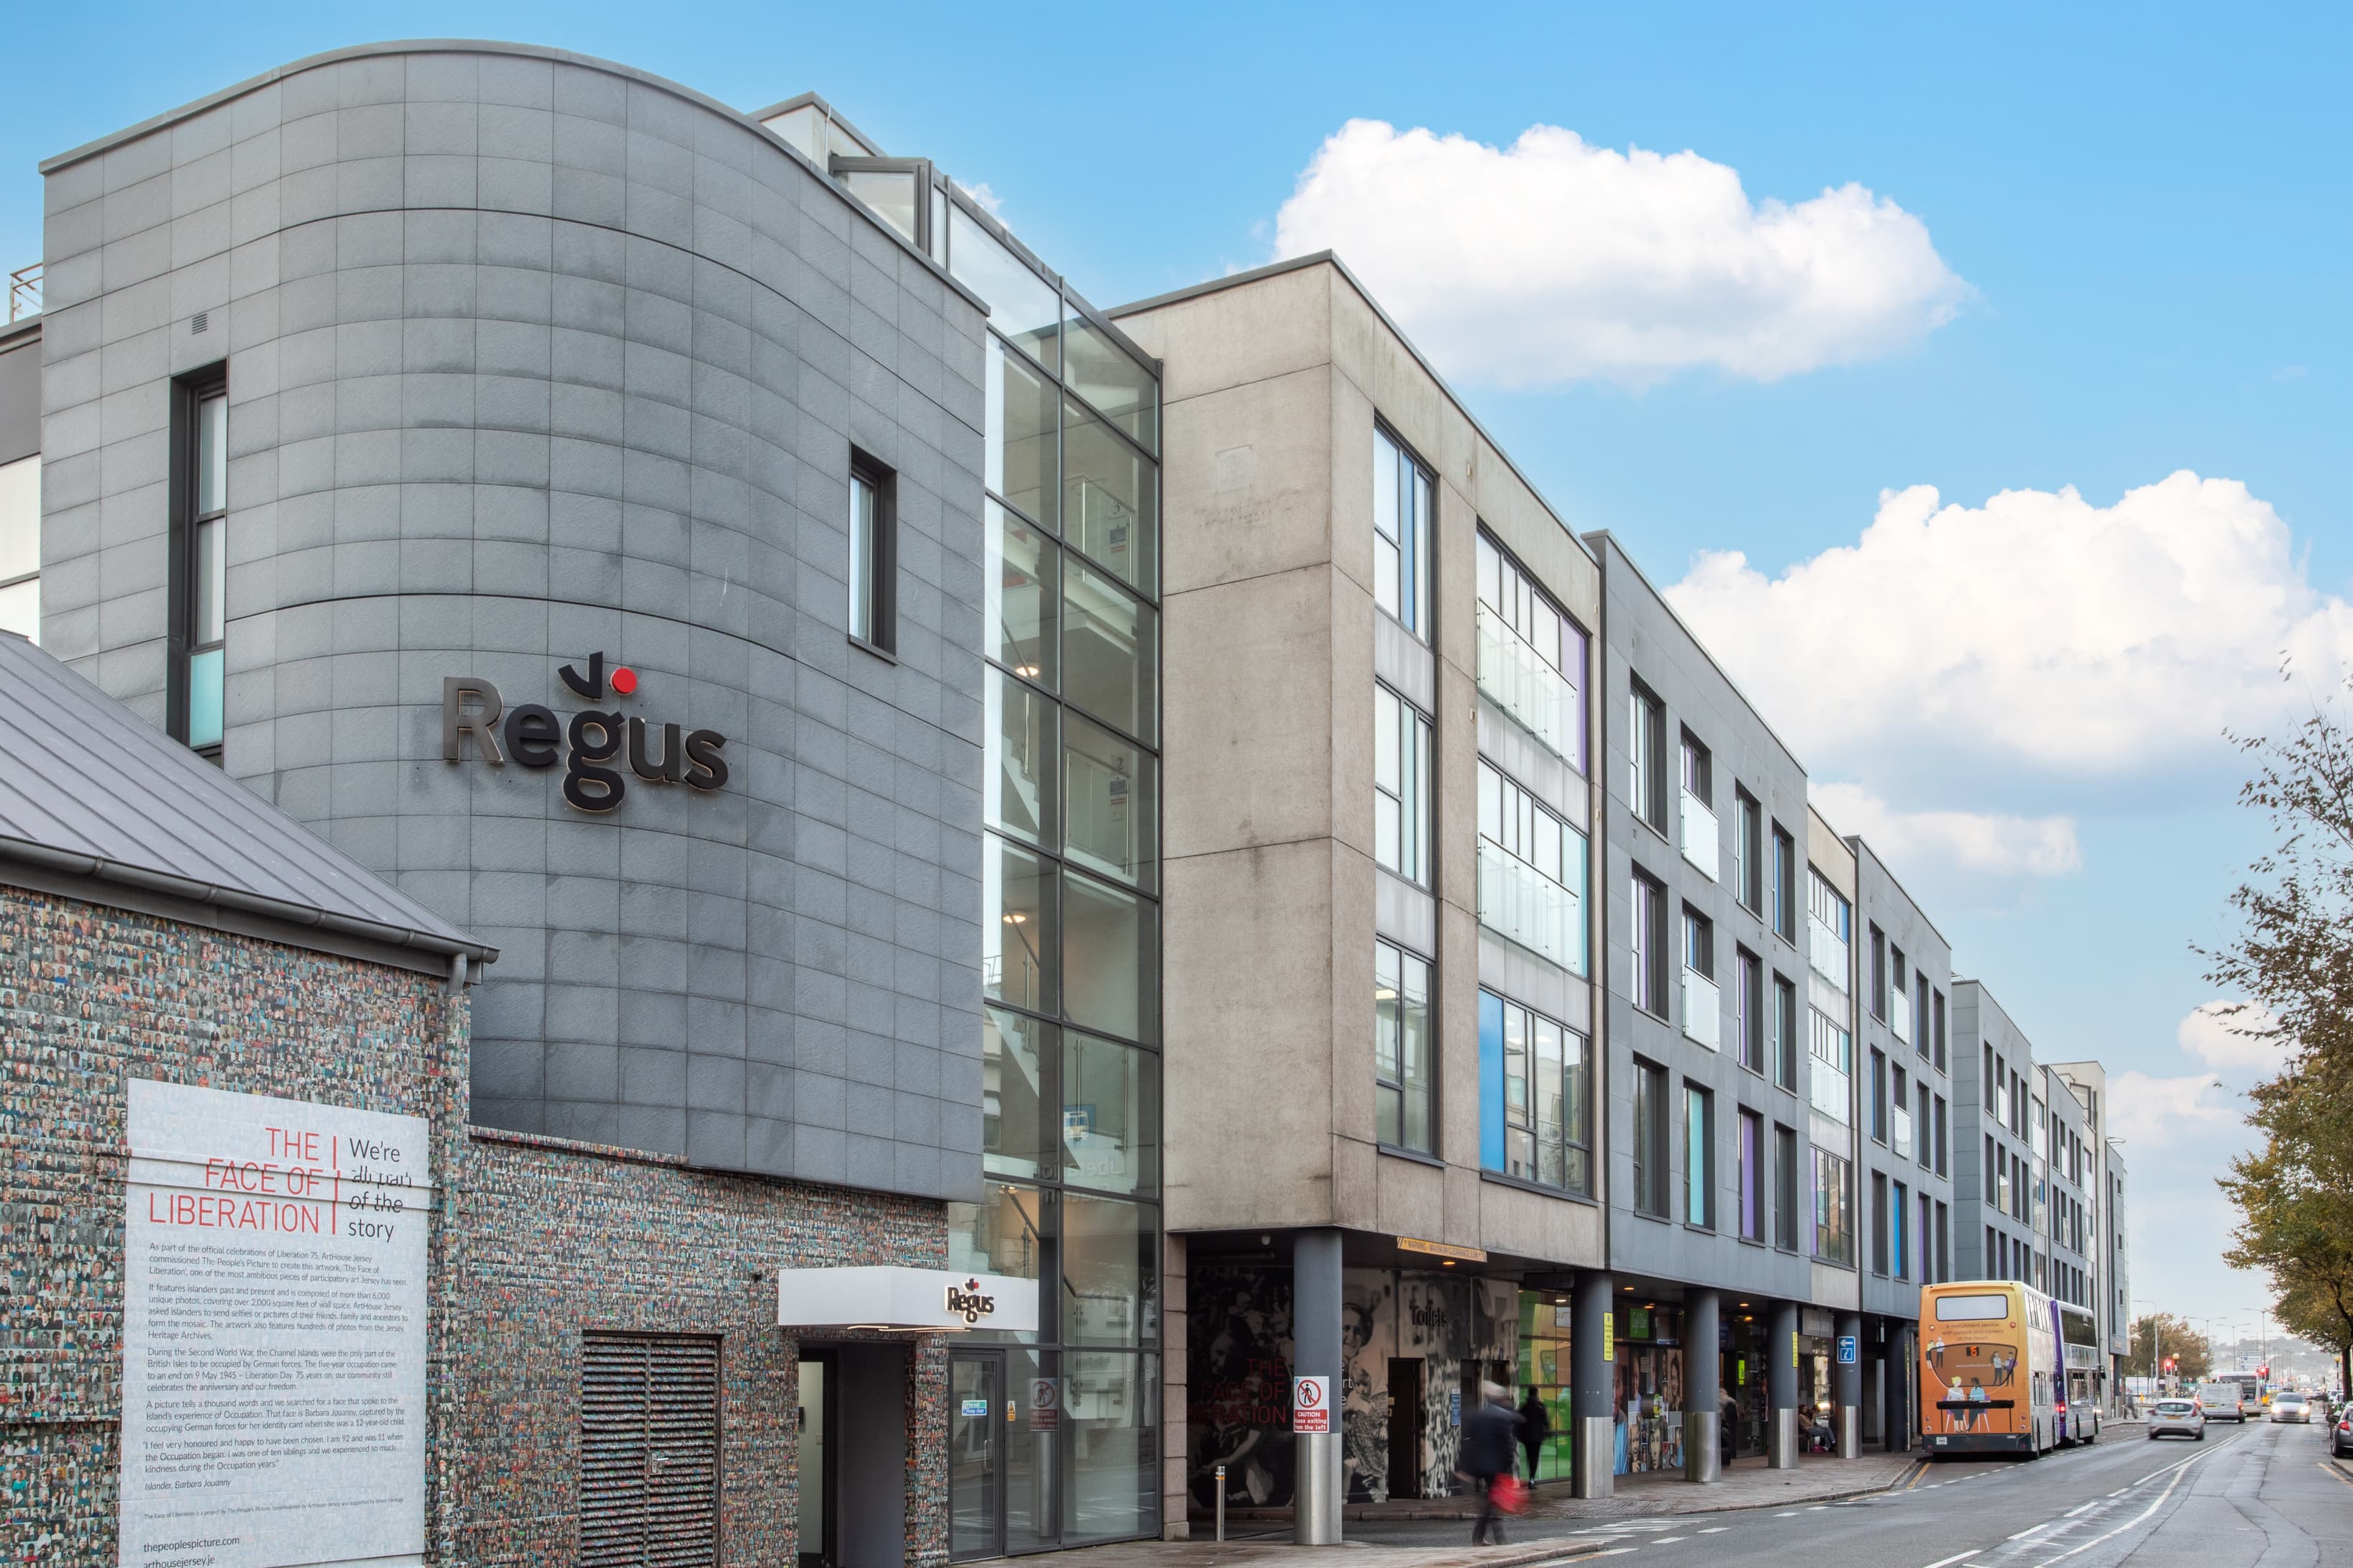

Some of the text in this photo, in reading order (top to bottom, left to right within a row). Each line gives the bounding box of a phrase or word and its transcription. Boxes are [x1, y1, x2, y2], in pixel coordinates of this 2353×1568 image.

[443, 676, 728, 812] Regus
[265, 1127, 320, 1162] THE
[349, 1137, 401, 1163] We're
[205, 1157, 324, 1196] FACE OF
[349, 1192, 403, 1213] of the
[149, 1192, 319, 1234] LIBERATION
[348, 1219, 394, 1243] story
[149, 1256, 200, 1265] commissioned
[201, 1257, 215, 1265] The
[217, 1258, 245, 1267] People's
[247, 1260, 270, 1268] Picture
[161, 1244, 176, 1253] part
[201, 1245, 224, 1254] official
[226, 1247, 266, 1256] celebrations
[277, 1250, 309, 1259] Liberation
[321, 1252, 351, 1261] ArtHouse
[352, 1255, 373, 1264] Jersey
[214, 1269, 225, 1278] the
[246, 1271, 278, 1280] ambitious
[280, 1273, 300, 1282] pieces
[310, 1275, 349, 1285] participatory
[360, 1277, 380, 1285] Jersey
[946, 1286, 995, 1324] Regus
[1409, 1304, 1448, 1326] Toilets
[147, 1348, 173, 1358] During
[349, 1349, 363, 1359] only
[210, 1360, 241, 1370] occupied
[242, 1360, 251, 1370] by
[318, 1360, 345, 1370] five-year
[347, 1361, 379, 1370] occupation
[1245, 1357, 1286, 1377] THE
[168, 1371, 182, 1380] end
[202, 1372, 216, 1381] May
[347, 1372, 380, 1380] community
[199, 1383, 239, 1393] anniversary
[1260, 1382, 1286, 1401] OF
[145, 1453, 158, 1462] the
[160, 1452, 201, 1462] Occupation
[283, 1447, 306, 1457] siblings
[332, 1445, 370, 1455] experienced
[145, 1464, 177, 1473] kindness
[178, 1464, 201, 1473] during
[217, 1462, 256, 1471] Occupation
[175, 1480, 202, 1489] Barbara
[144, 1536, 239, 1553] thepeoplespicture.com
[143, 1555, 215, 1568] arthousejersey.je
